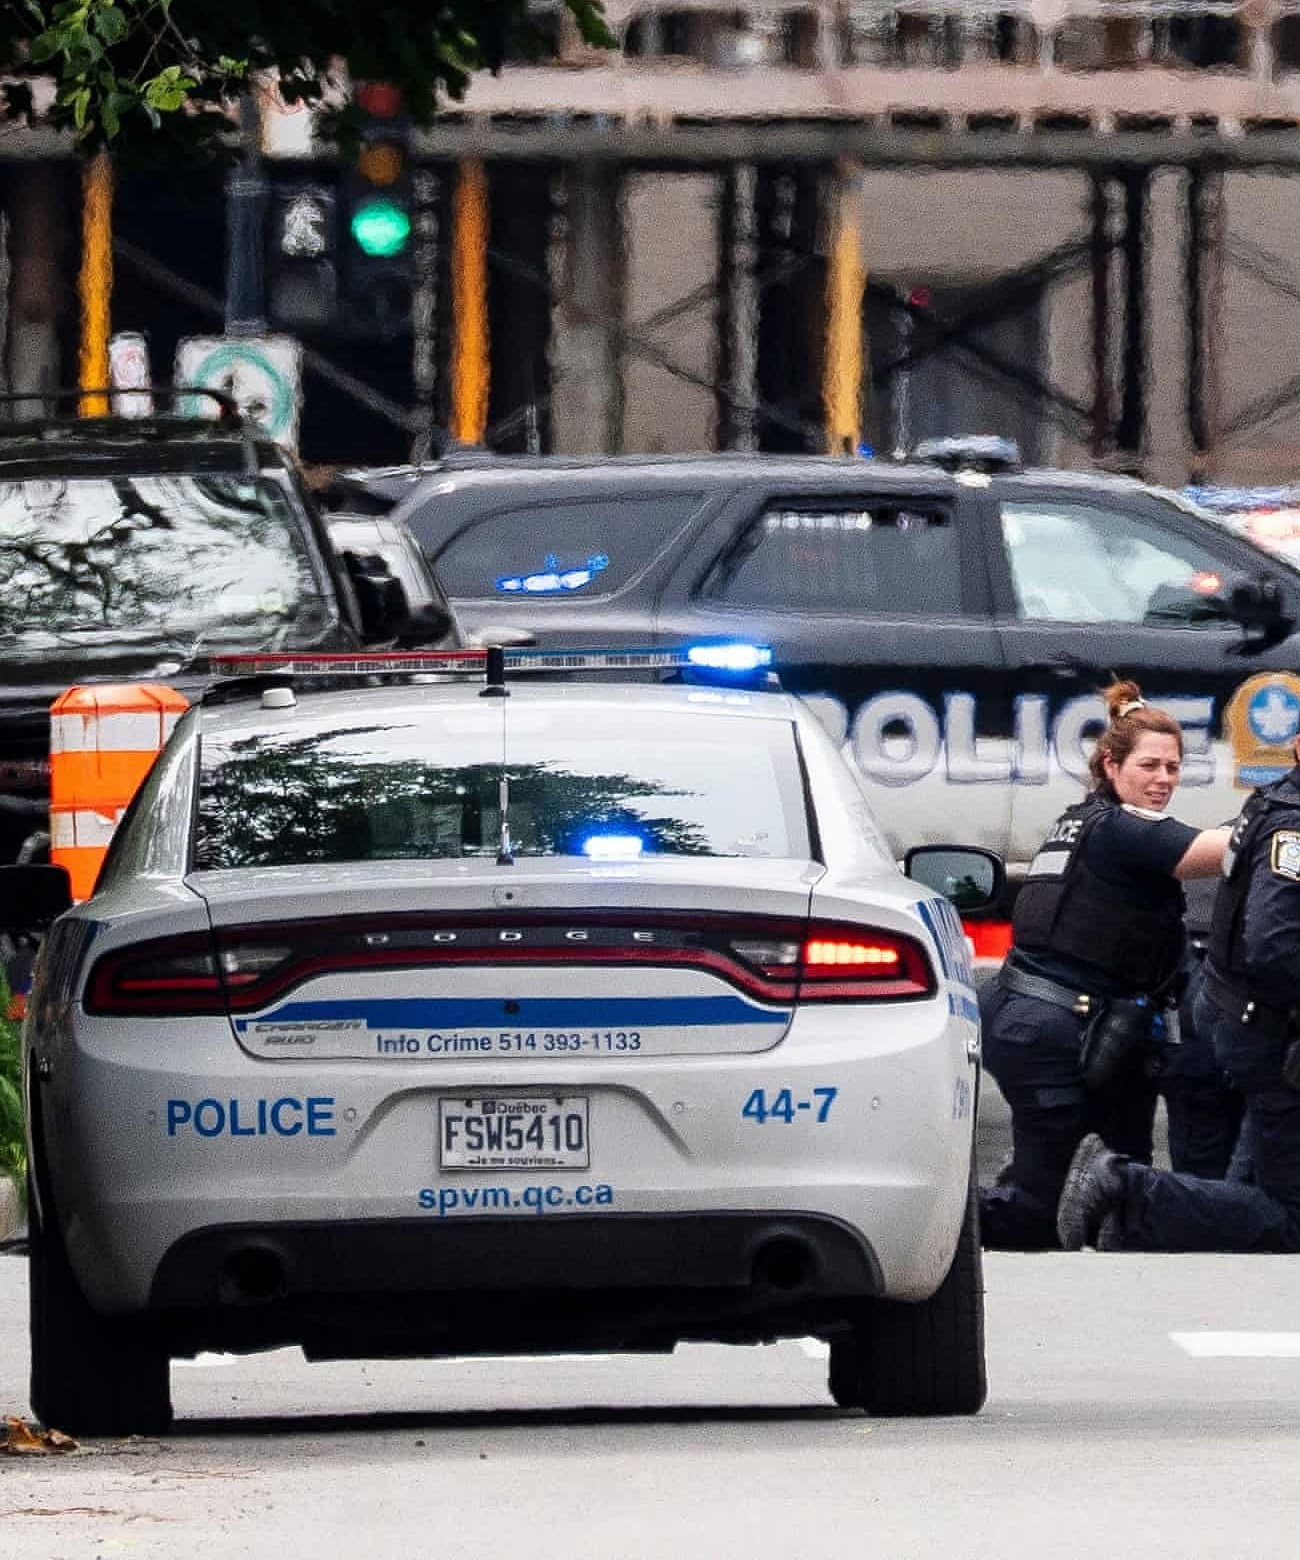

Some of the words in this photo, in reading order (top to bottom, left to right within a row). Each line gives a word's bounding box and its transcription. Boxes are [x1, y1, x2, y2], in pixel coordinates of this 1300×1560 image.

[365, 930, 656, 945] DODGE
[376, 1034, 420, 1053] Info
[427, 1033, 491, 1053] Crime
[499, 1033, 537, 1052] 514
[543, 1032, 642, 1052] 393-1133
[167, 1097, 337, 1138] POLICE
[497, 1101, 548, 1115] Québec
[742, 1087, 840, 1124] 44-7
[445, 1114, 584, 1151] FSW5410
[419, 1183, 614, 1217] spvm.qc.ca
